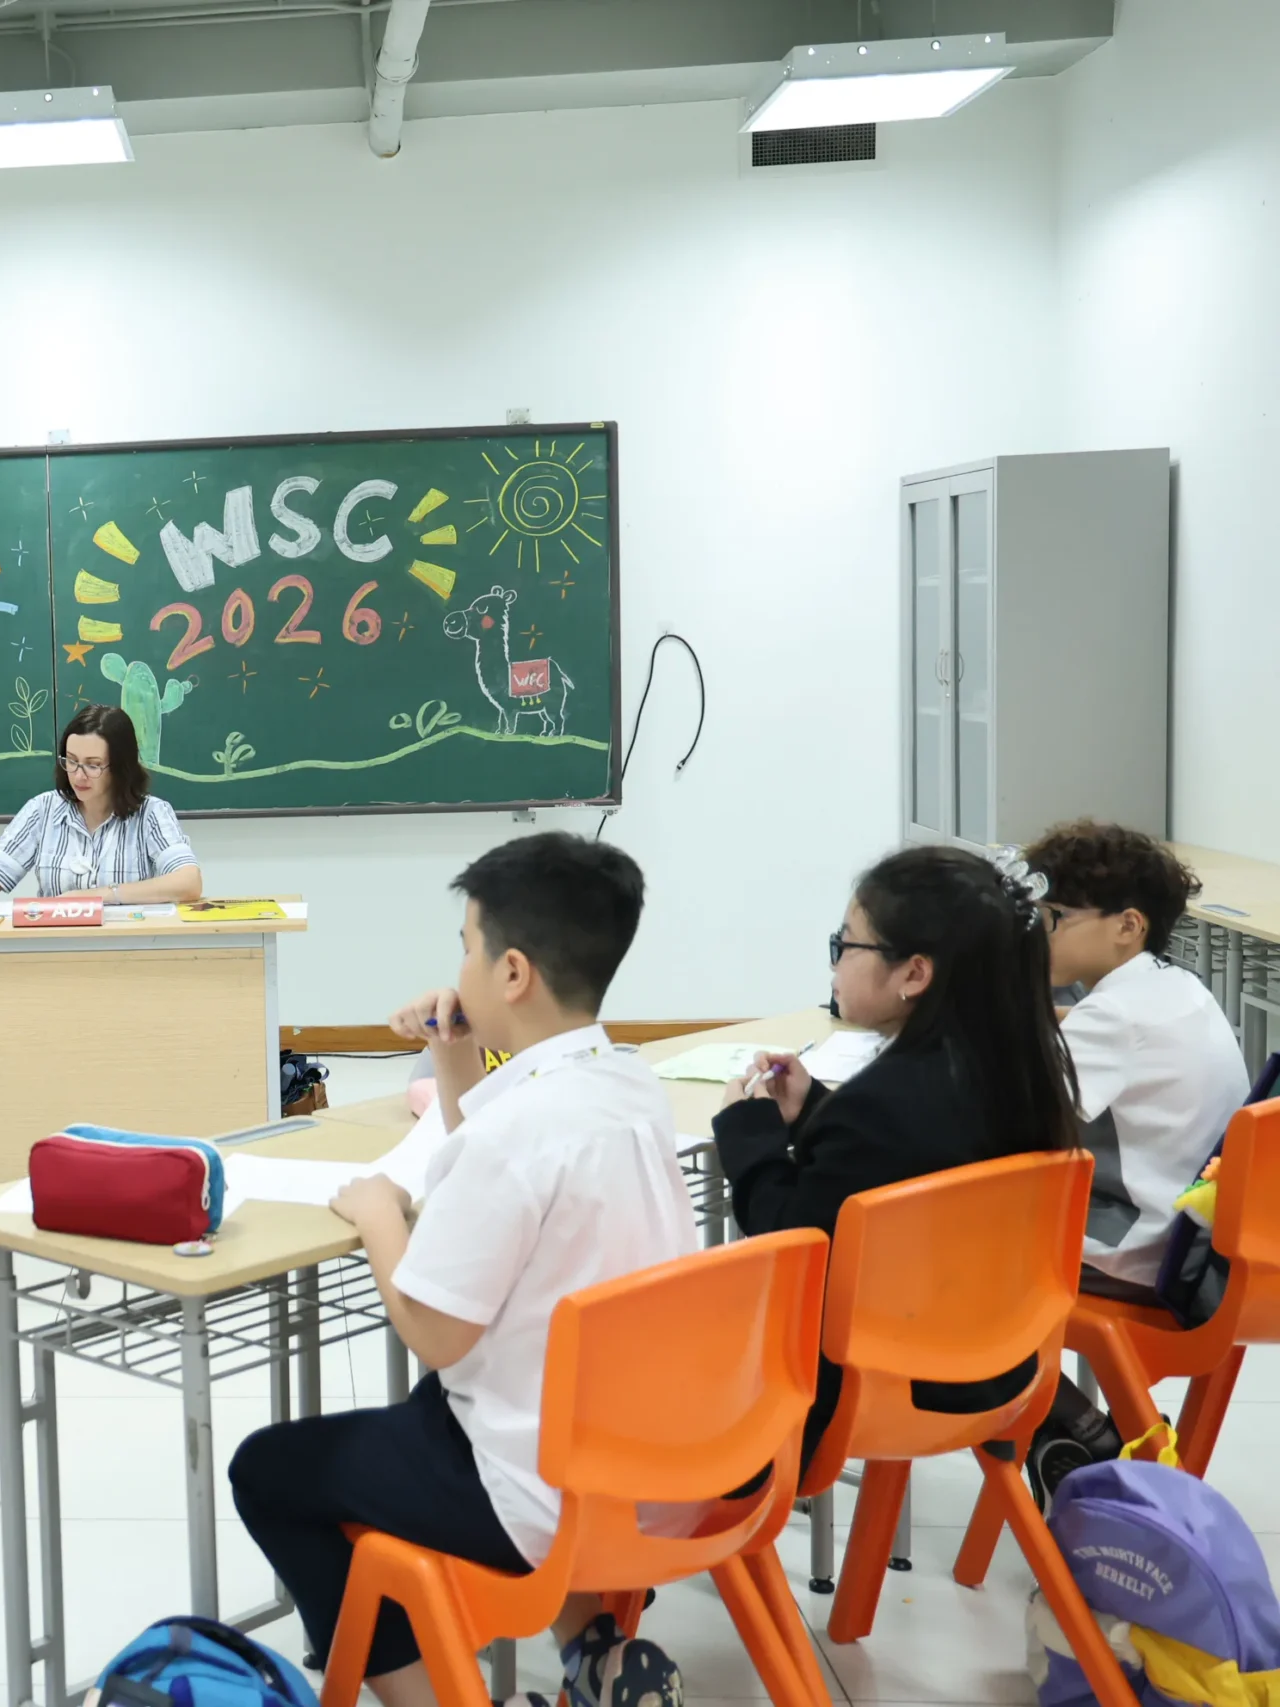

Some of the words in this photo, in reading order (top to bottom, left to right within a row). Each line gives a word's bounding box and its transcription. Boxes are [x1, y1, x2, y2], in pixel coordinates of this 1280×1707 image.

[158, 475, 399, 592] WSC
[149, 574, 382, 670] 2026
[51, 901, 96, 918] ADJ
[1095, 1561, 1156, 1601] BERKELEY
[1099, 1546, 1145, 1570] NORTH
[1145, 1560, 1174, 1595] FACE
